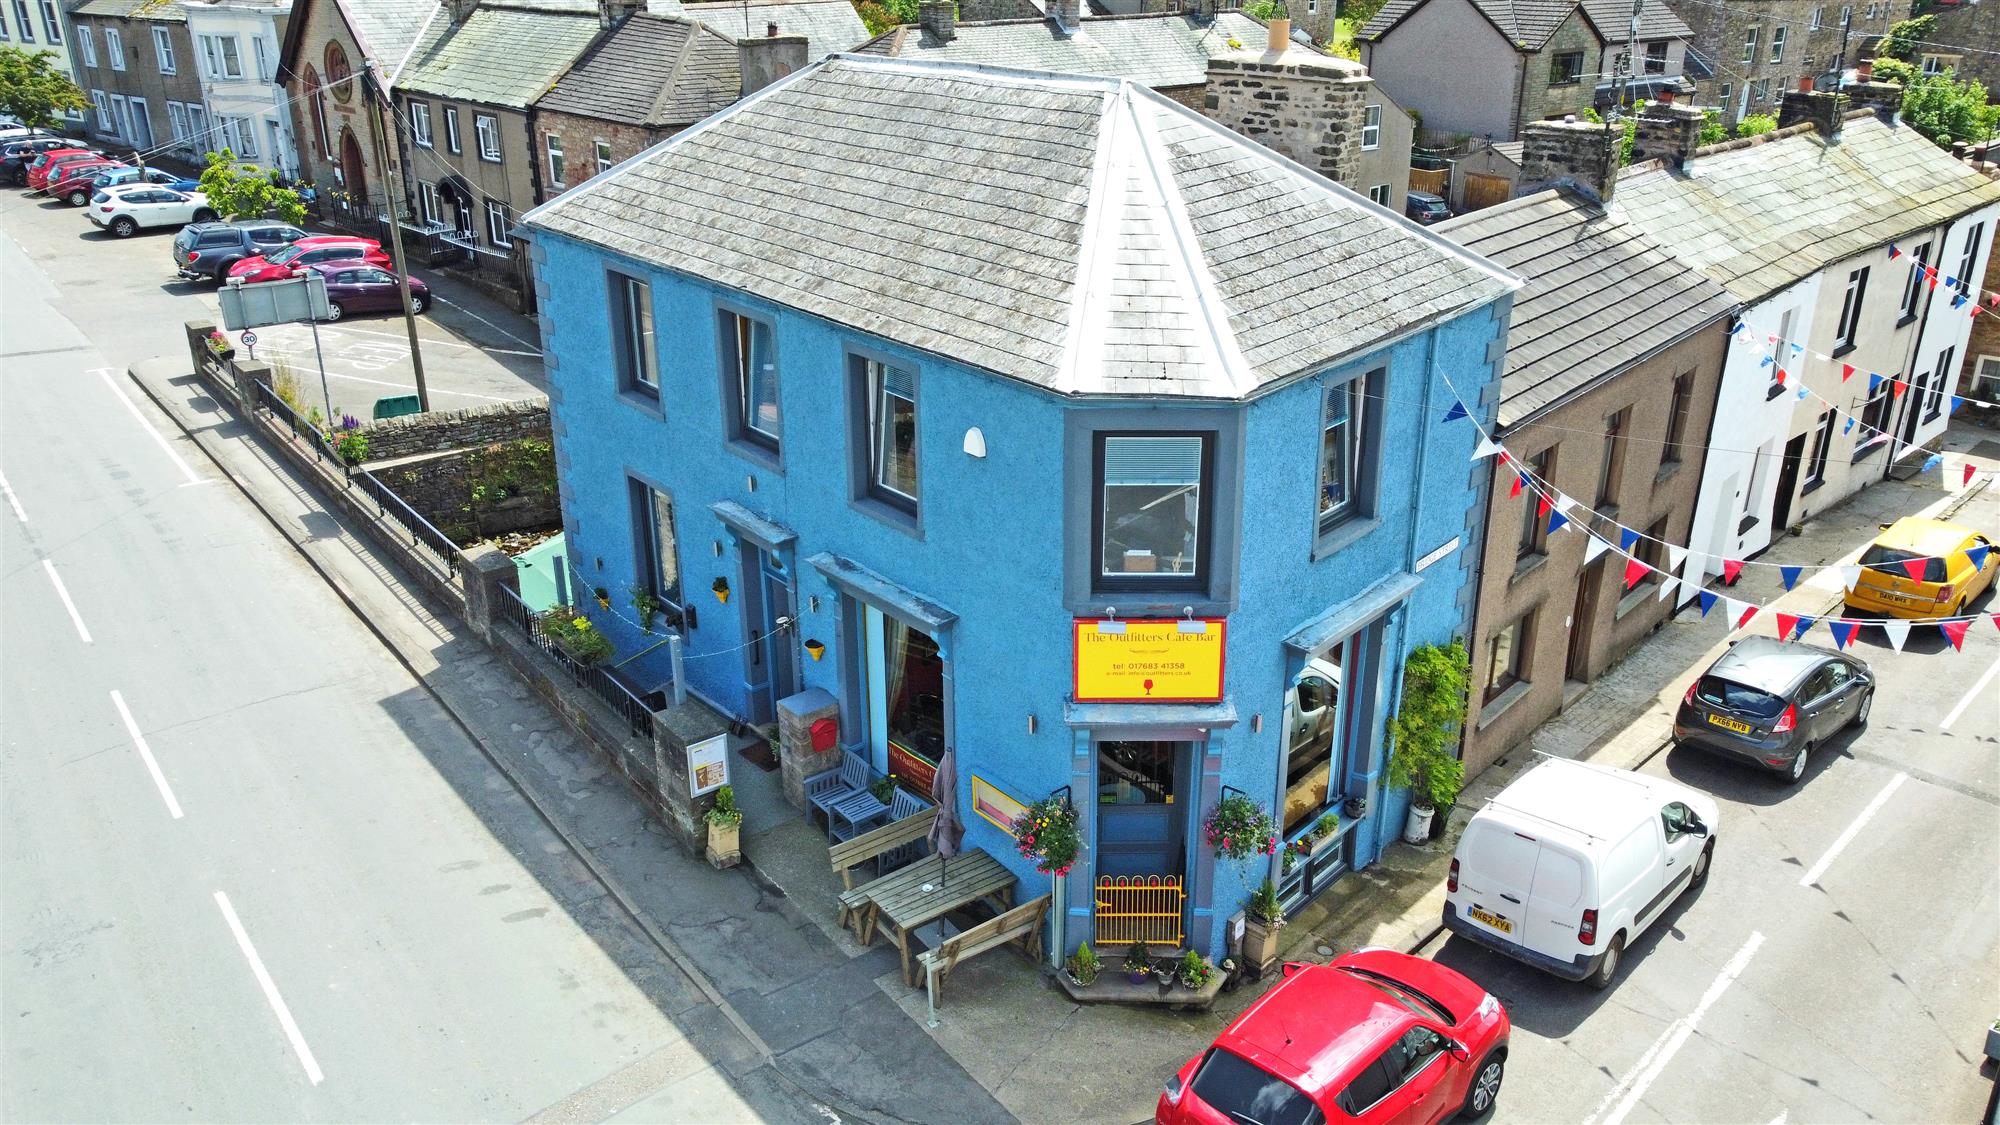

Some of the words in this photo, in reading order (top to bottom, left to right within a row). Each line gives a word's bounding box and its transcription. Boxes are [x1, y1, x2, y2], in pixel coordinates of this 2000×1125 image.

[244, 335, 255, 343] 30
[1085, 632, 1106, 643] The
[1109, 632, 1163, 643] Outfitters
[1196, 632, 1216, 642] Bar
[1472, 909, 1492, 923] NX62
[1494, 918, 1510, 932] XYA
